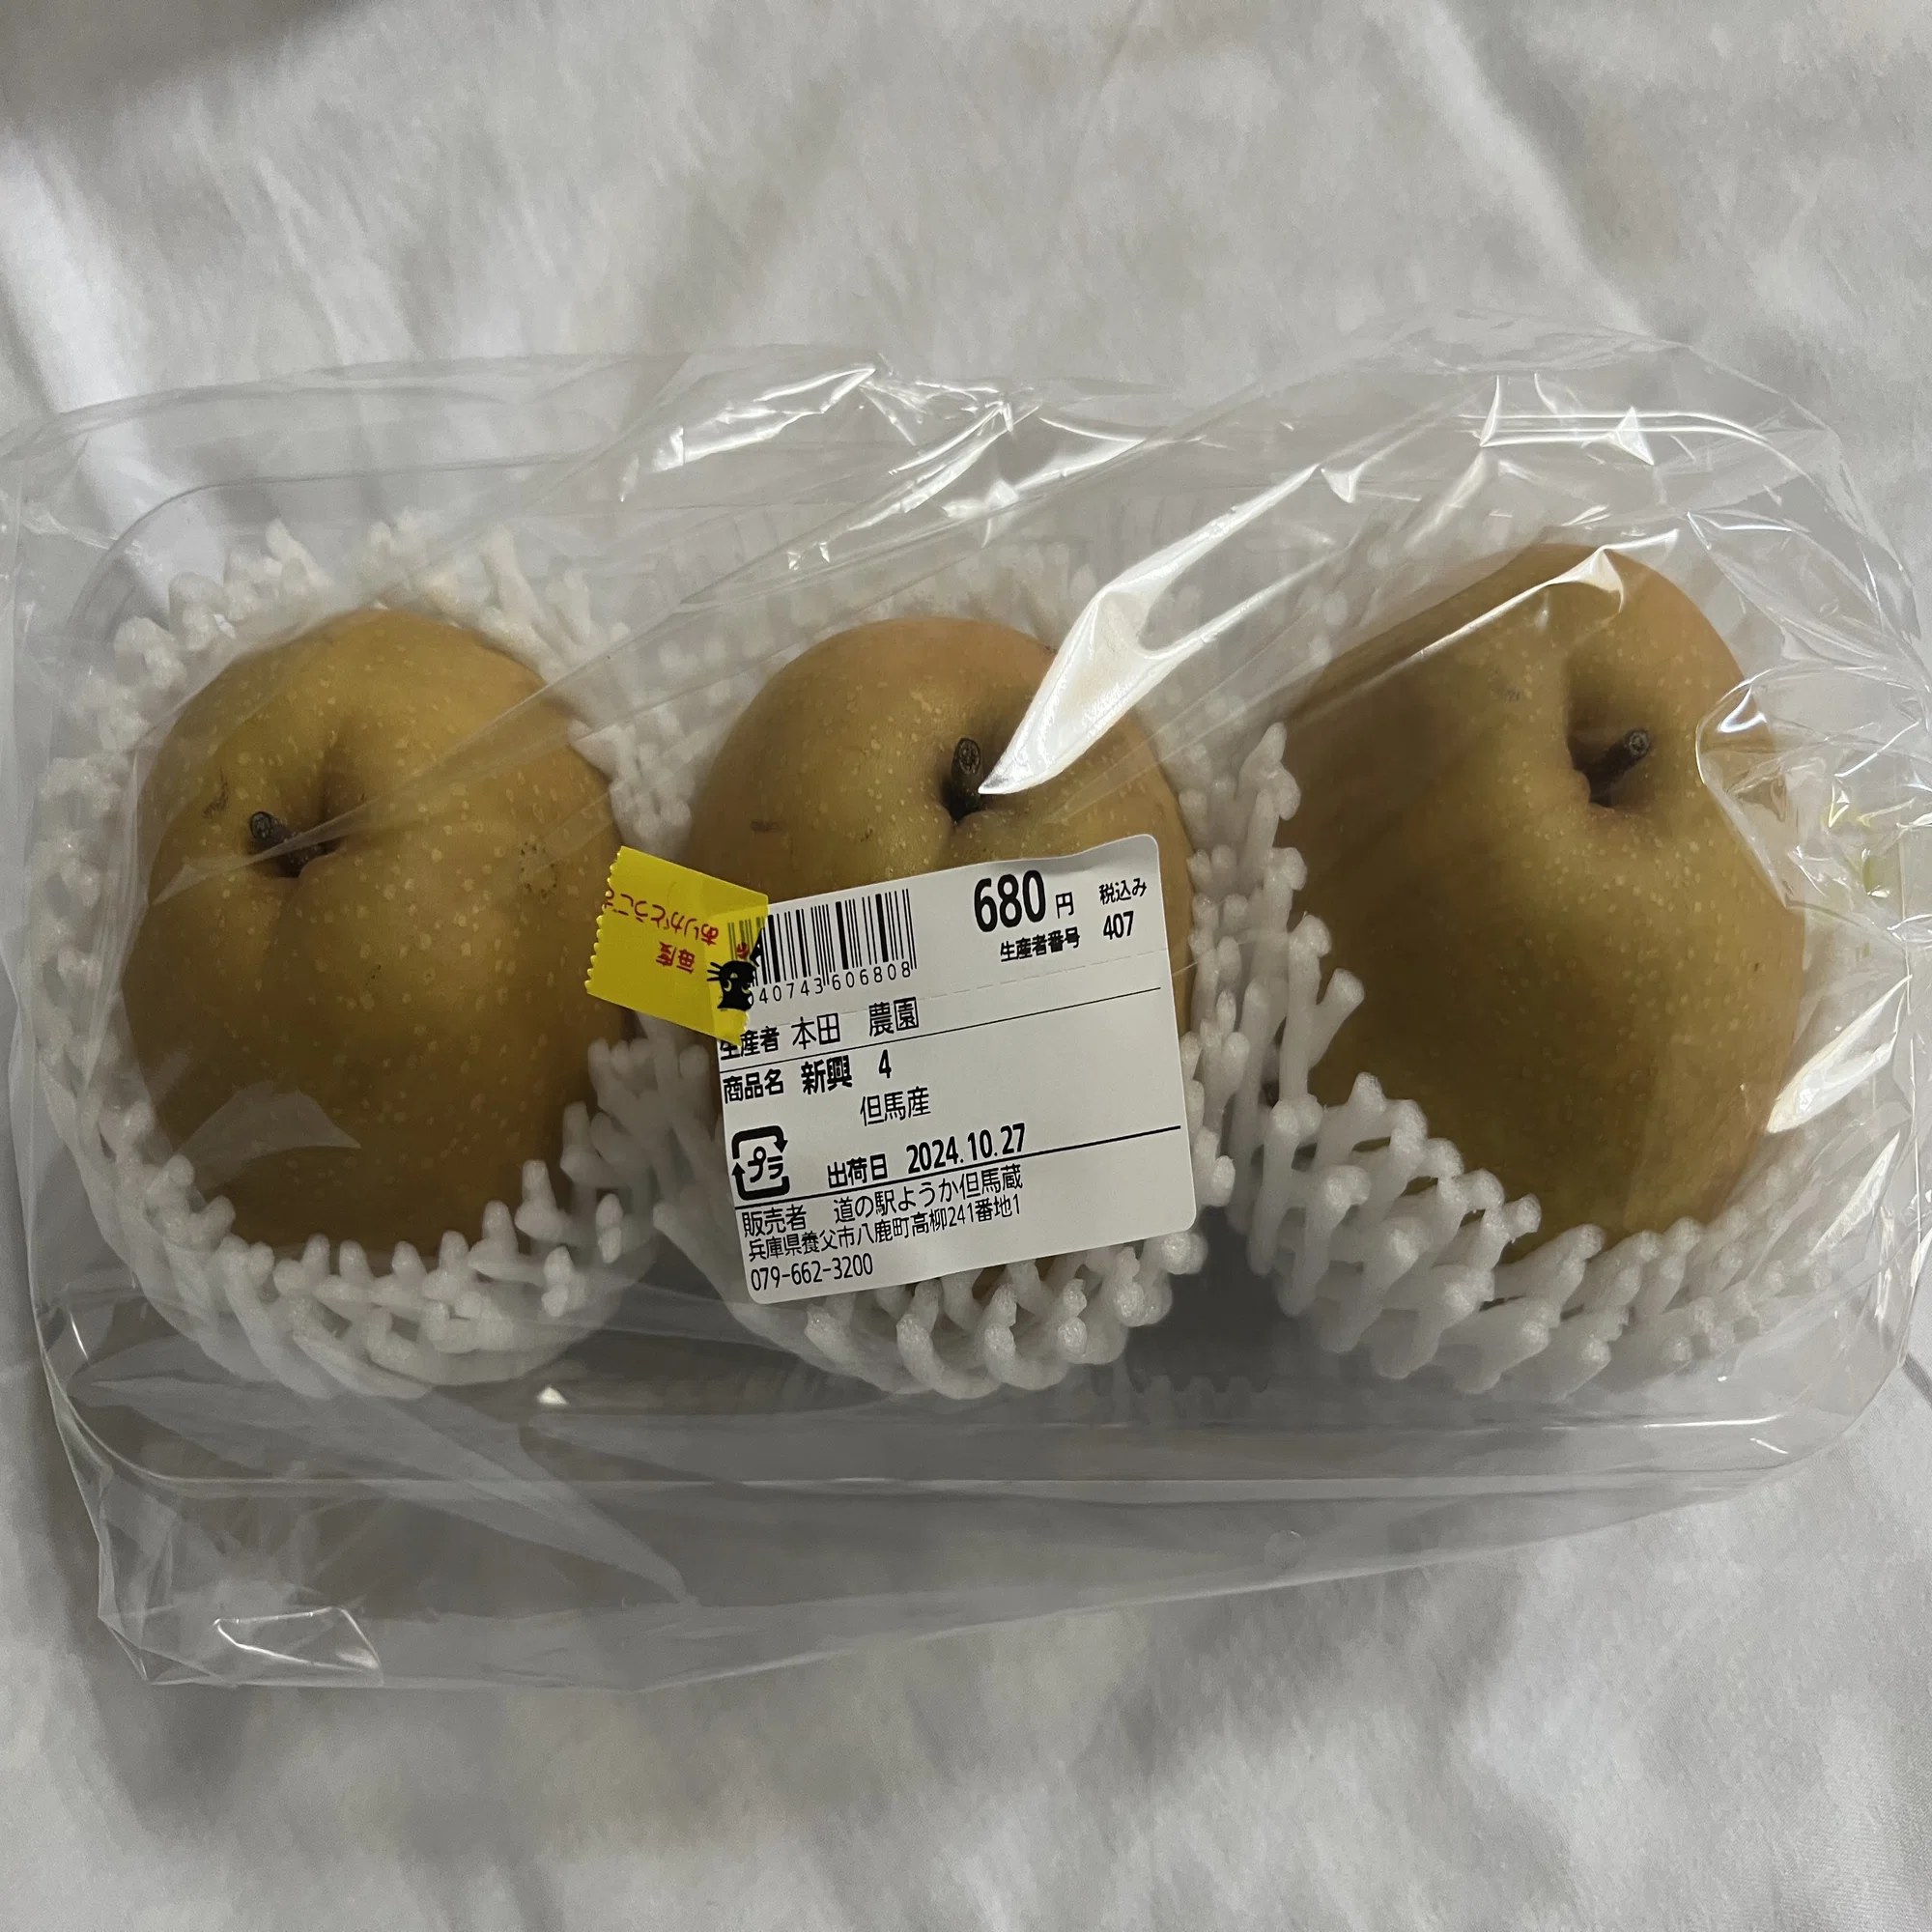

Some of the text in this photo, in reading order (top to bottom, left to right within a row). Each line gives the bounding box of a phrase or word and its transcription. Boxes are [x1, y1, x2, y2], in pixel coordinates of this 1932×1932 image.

[974, 870, 1147, 932] 680 円 税込み
[656, 942, 696, 974] 毎度
[1000, 911, 1134, 962] 生産者番号 407
[720, 997, 919, 1060] 生産者 本田 農園
[723, 1049, 892, 1103] 商品名 新興 4
[860, 1086, 931, 1126] 但馬産
[748, 1147, 783, 1182] プラ
[827, 1122, 1025, 1188] 出荷日 2024.10.27
[742, 1163, 1023, 1237] 販売者 道の駅ようか但馬蔵
[749, 1194, 1020, 1262] 兵庫県養父市八鹿町高柳241番地1
[751, 1253, 873, 1292] 079-662-3200
